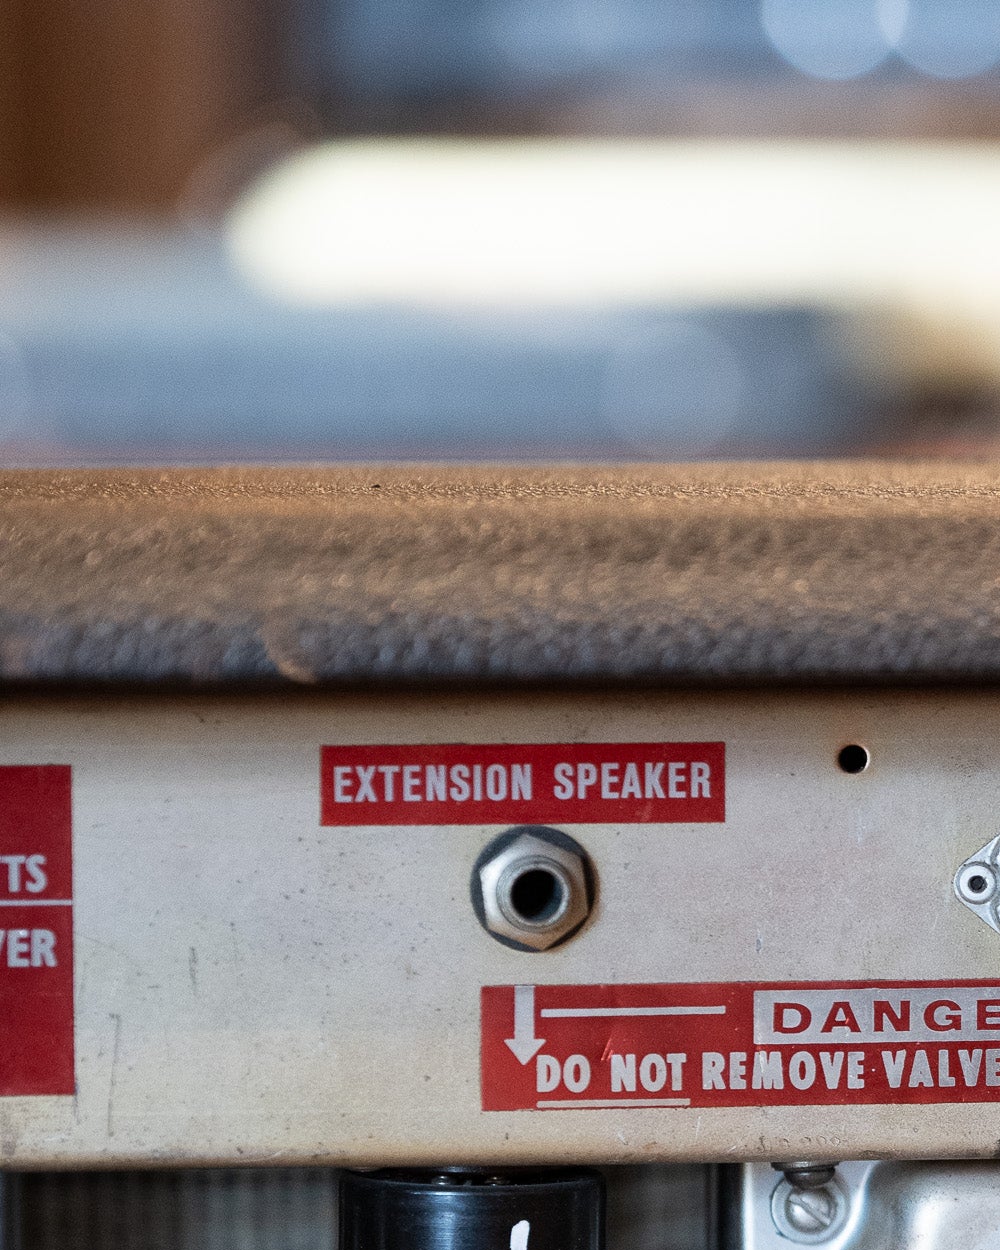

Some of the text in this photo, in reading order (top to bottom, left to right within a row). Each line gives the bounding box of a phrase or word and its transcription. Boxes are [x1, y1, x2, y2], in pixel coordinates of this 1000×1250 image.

[333, 762, 711, 803] EXTENSION SPEAKER
[0, 929, 57, 968] ER
[536, 1054, 592, 1093] DO
[610, 1053, 688, 1093] NOT
[702, 1051, 866, 1091] REMOVE
